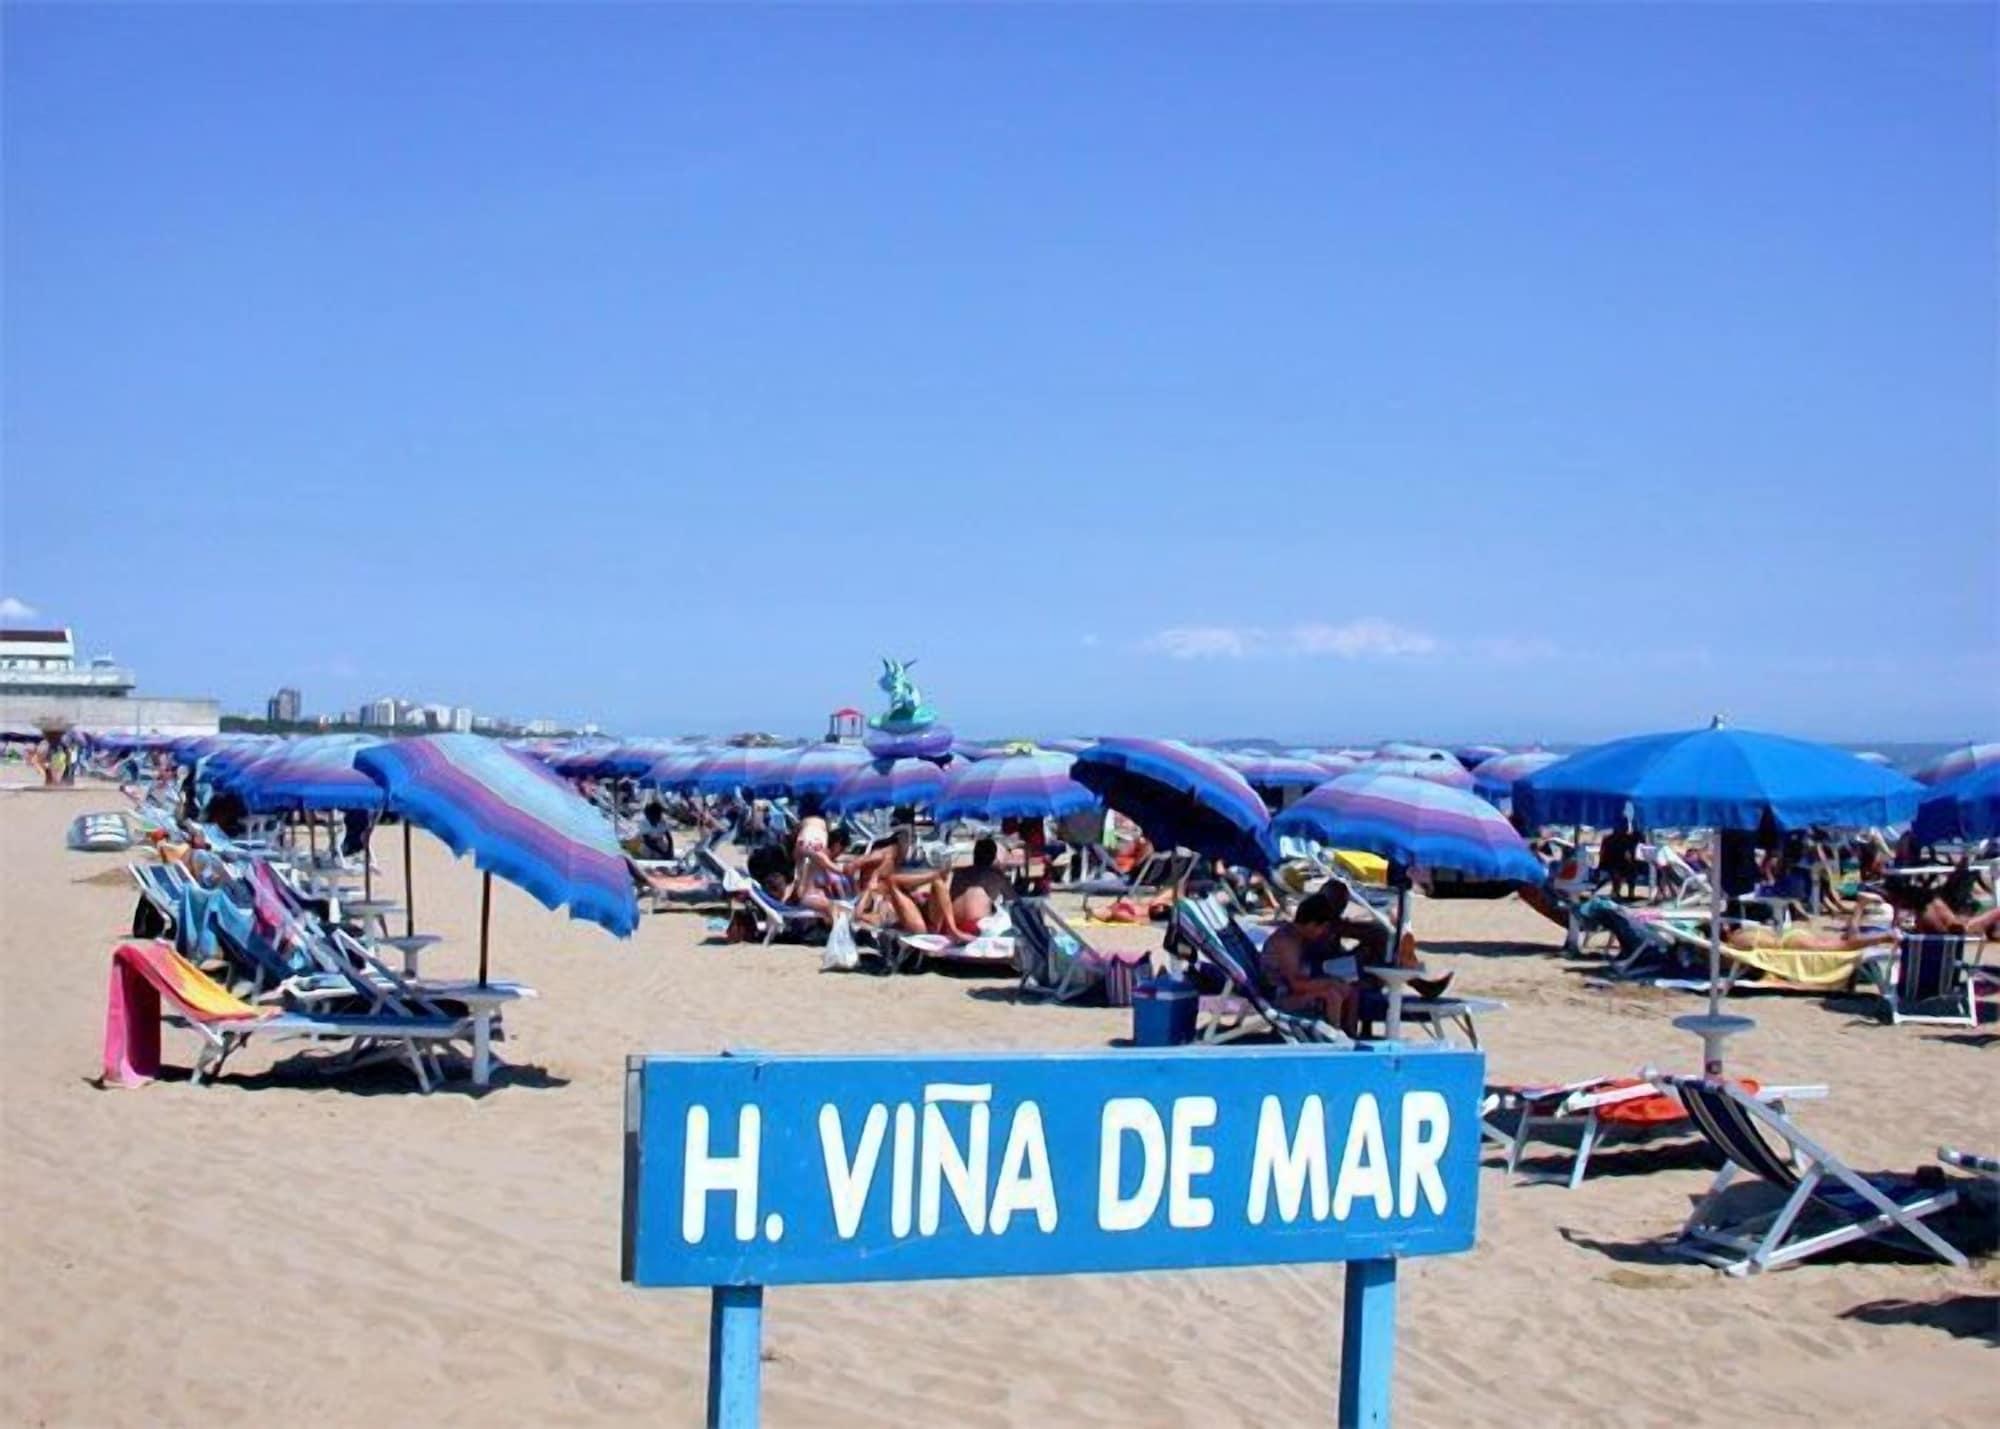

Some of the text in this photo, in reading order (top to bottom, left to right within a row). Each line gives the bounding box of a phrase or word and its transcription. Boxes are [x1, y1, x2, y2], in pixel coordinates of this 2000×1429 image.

[682, 1083, 1451, 1243] H. VIÑA DE MAR
